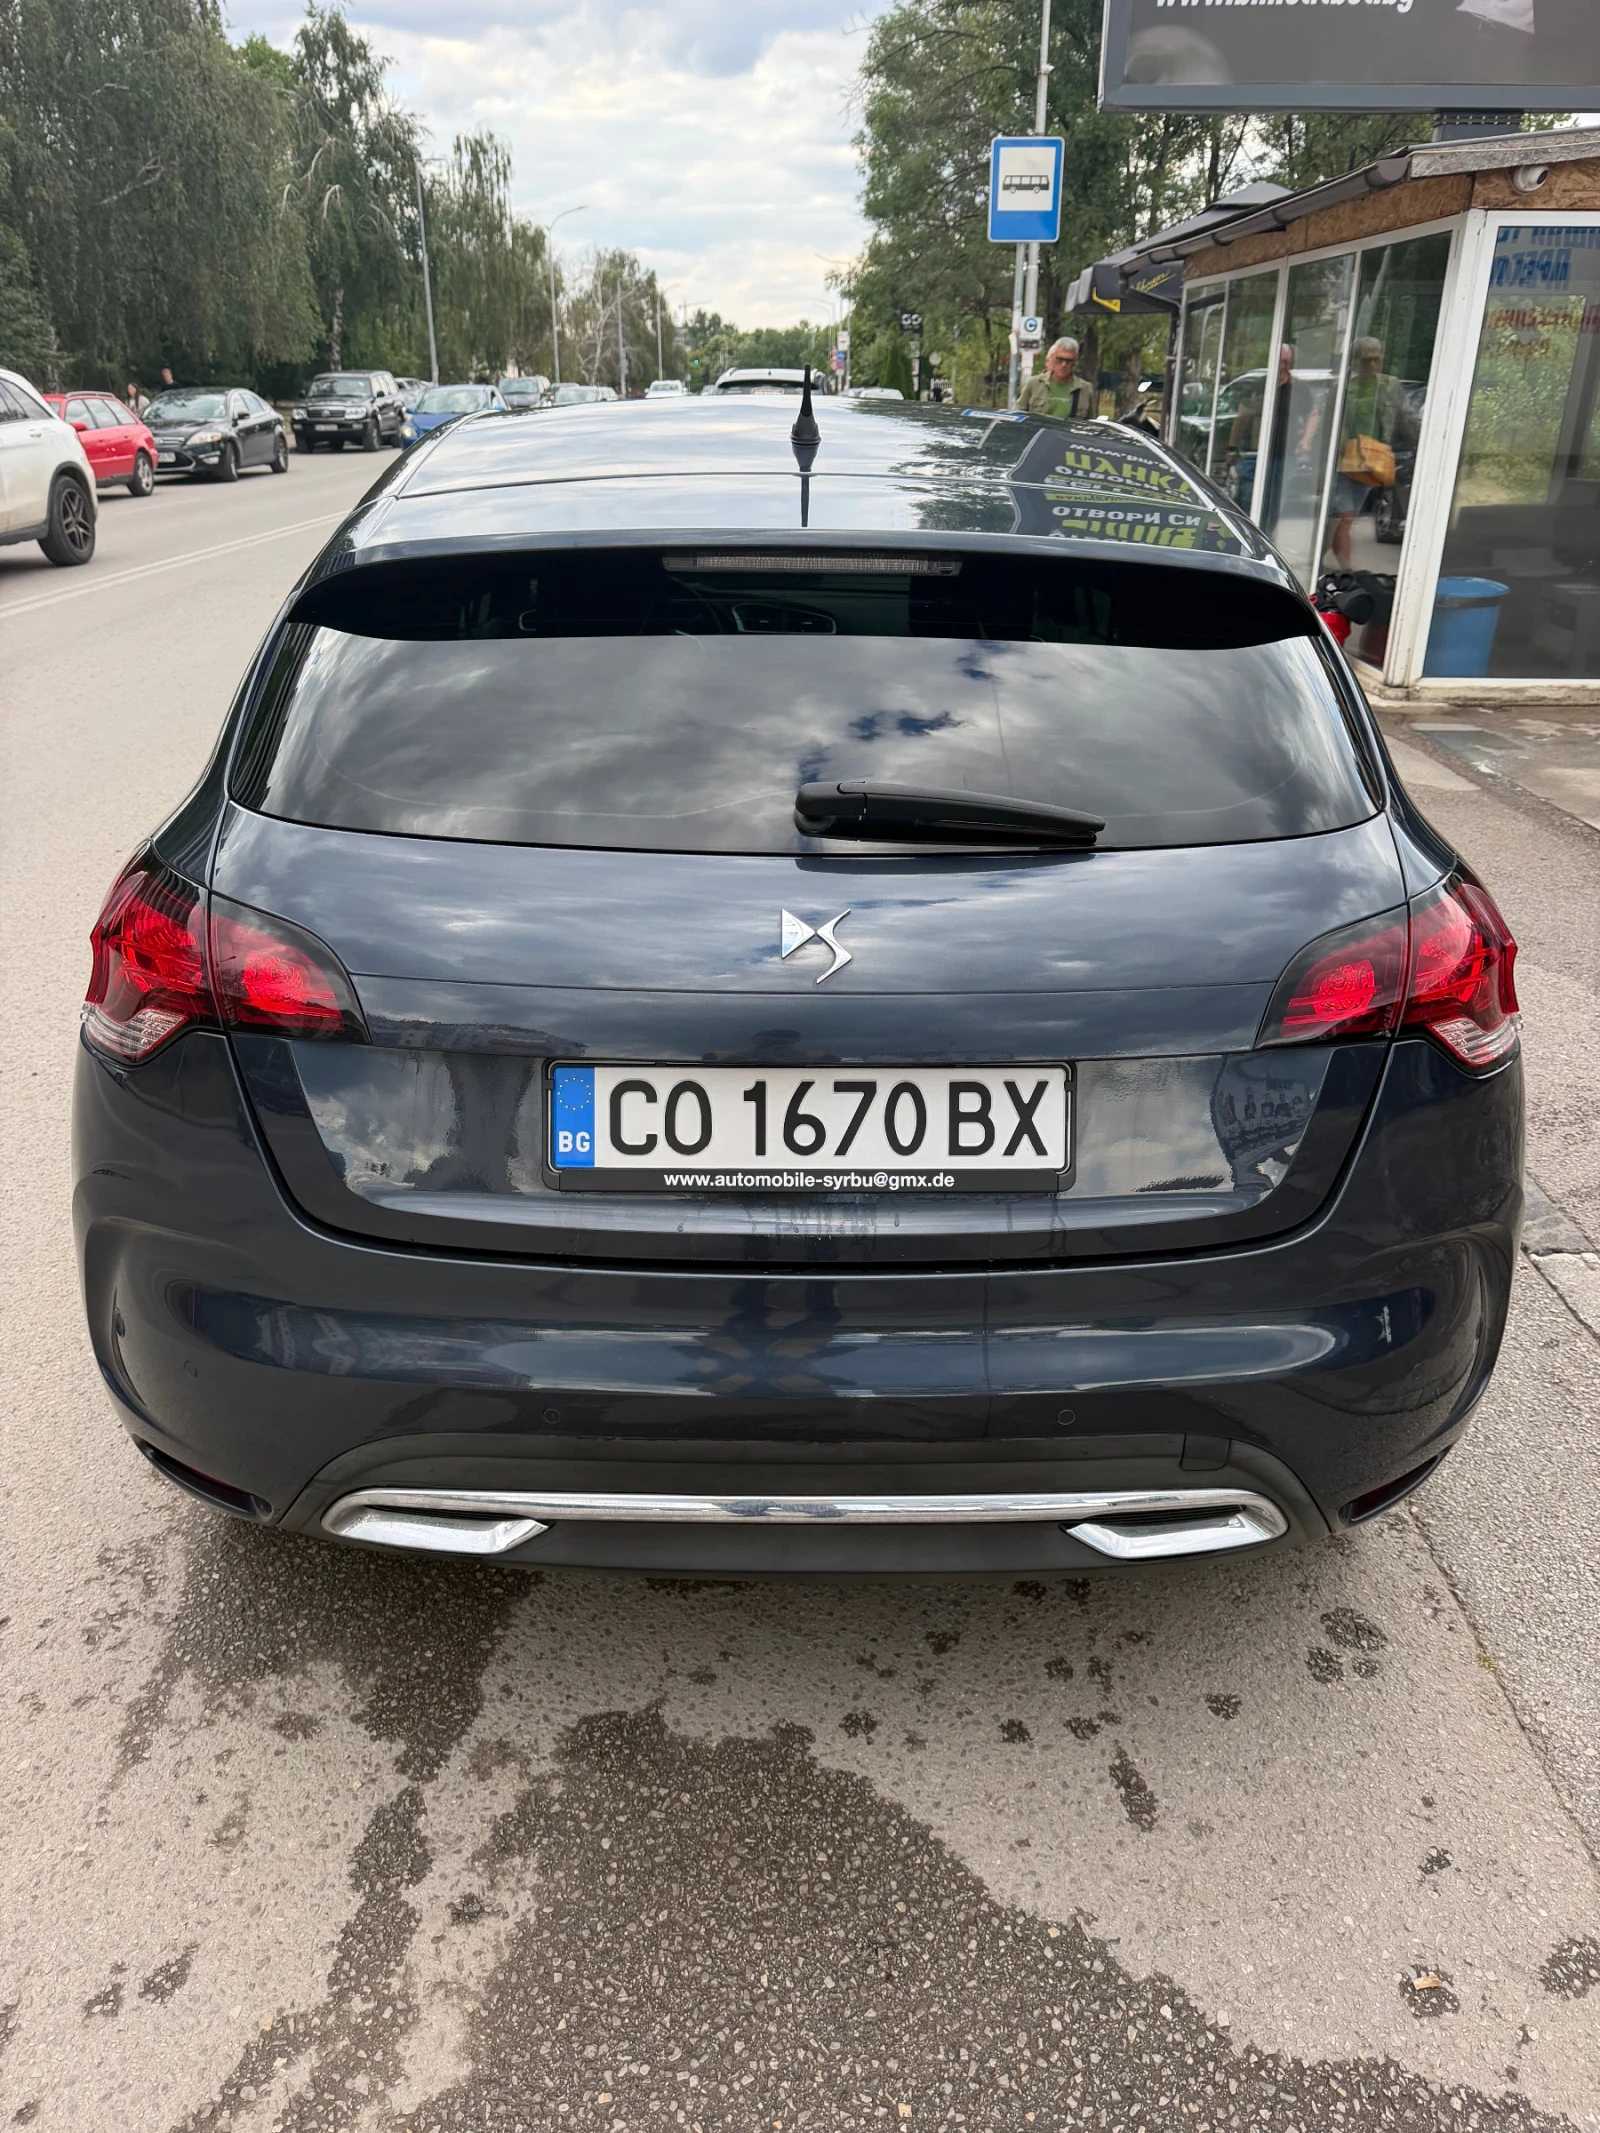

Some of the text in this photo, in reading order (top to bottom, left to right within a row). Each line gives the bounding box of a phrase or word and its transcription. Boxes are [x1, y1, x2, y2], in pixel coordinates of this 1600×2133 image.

[608, 1079, 1051, 1157] CO 1670 BX
[557, 1130, 591, 1153] BG
[663, 1171, 956, 1190] www.automobile-syrbu@gmx.de
